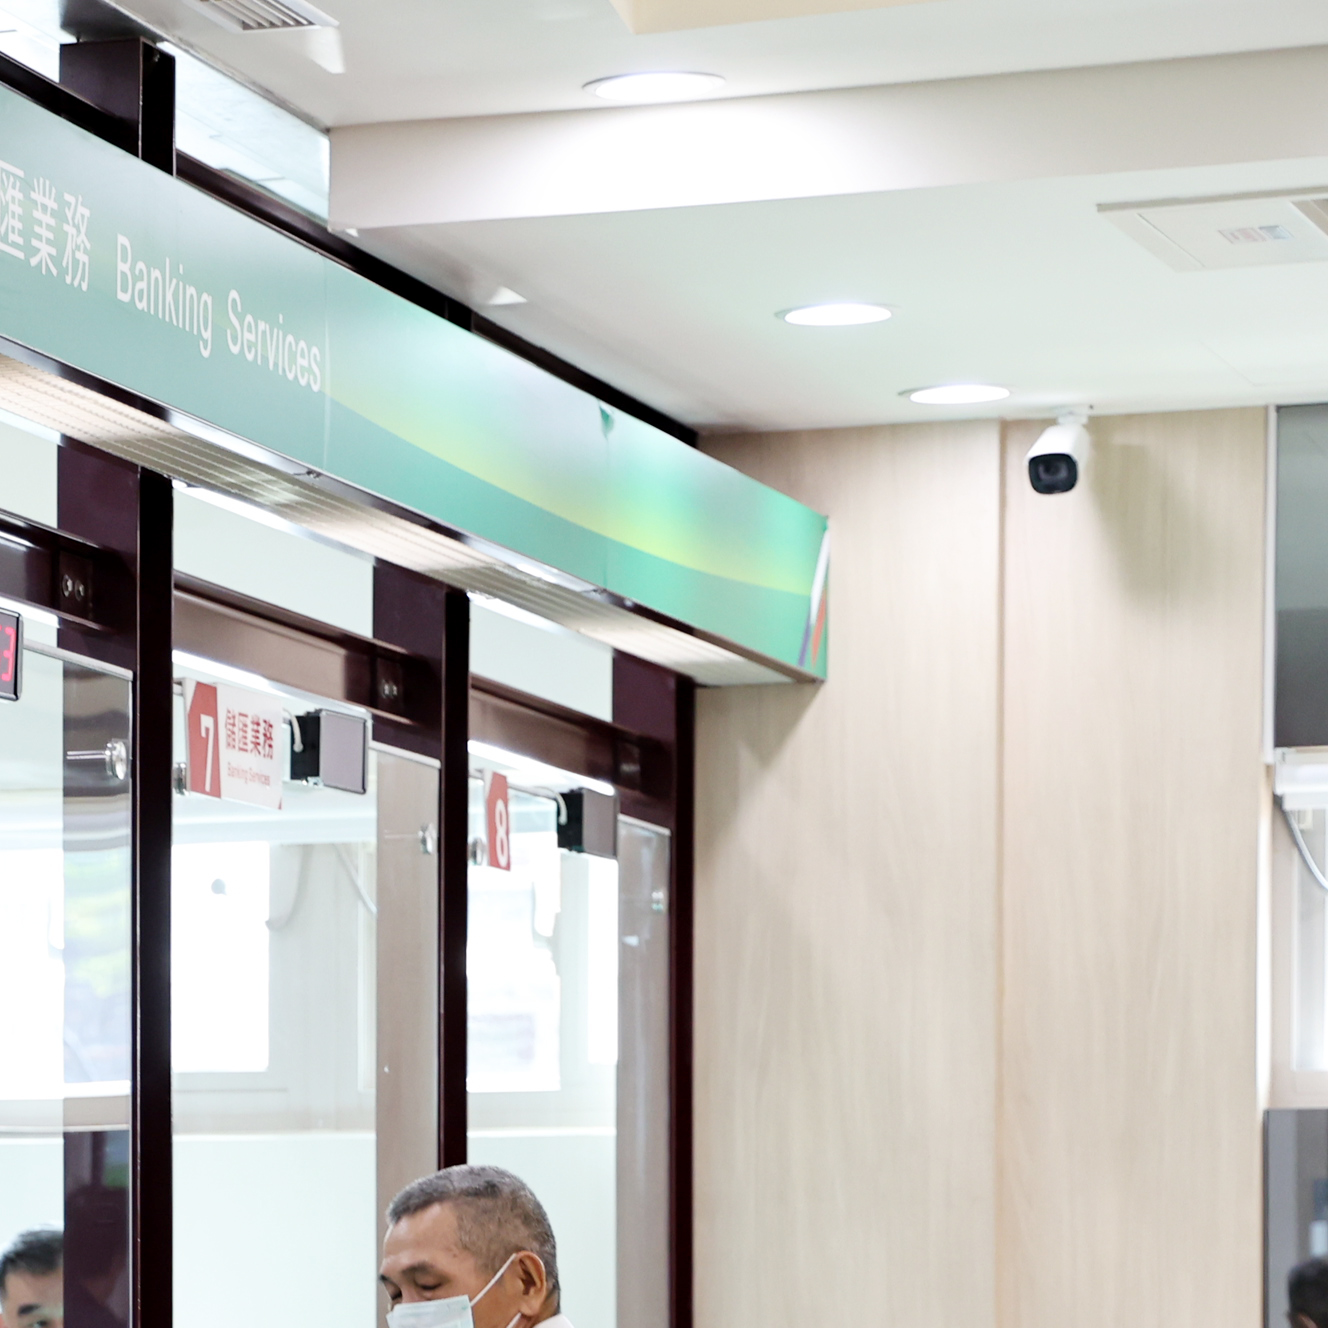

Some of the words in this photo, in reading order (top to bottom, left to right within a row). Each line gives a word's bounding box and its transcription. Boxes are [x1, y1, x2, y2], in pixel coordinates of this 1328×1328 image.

[115, 233, 213, 359] Banking
[226, 289, 322, 393] Services
[200, 714, 215, 792] 7
[225, 707, 274, 761] 儲匯業務
[227, 761, 248, 785] Banking
[495, 799, 508, 870] 8
